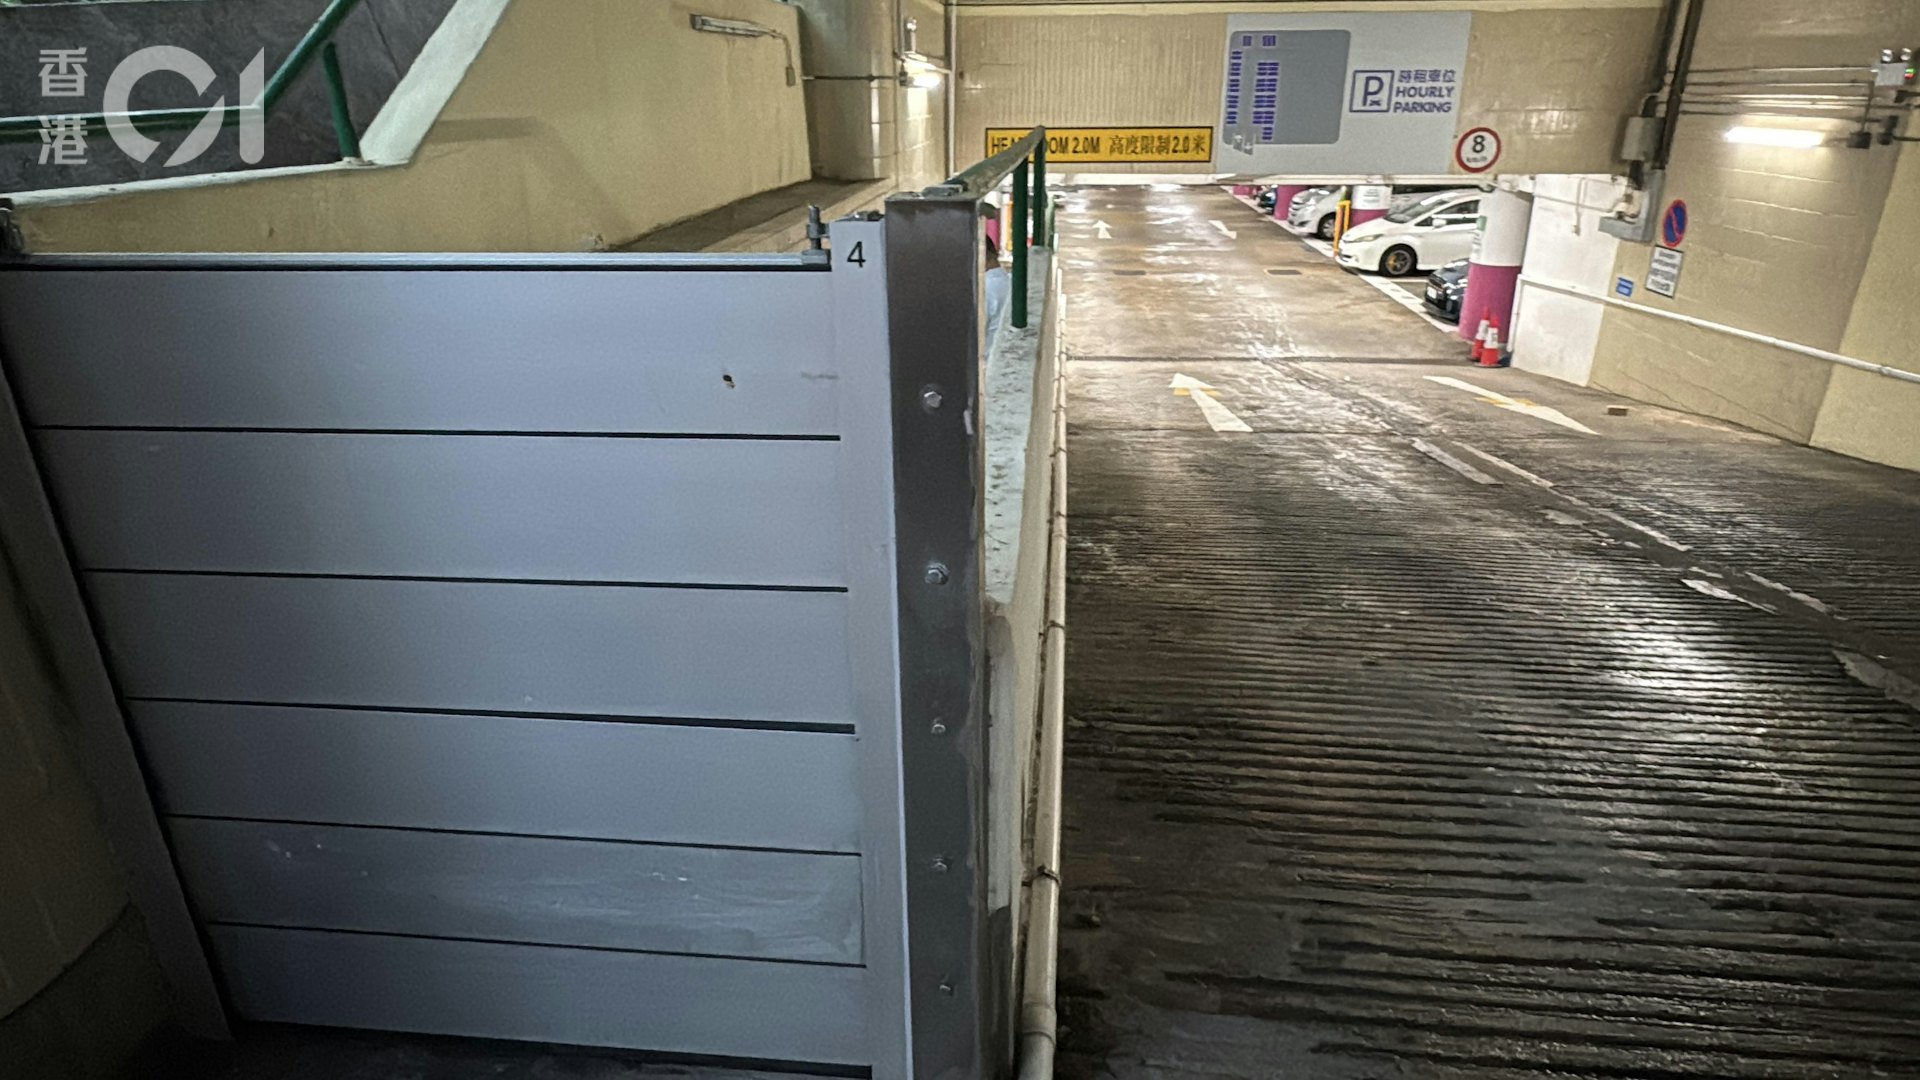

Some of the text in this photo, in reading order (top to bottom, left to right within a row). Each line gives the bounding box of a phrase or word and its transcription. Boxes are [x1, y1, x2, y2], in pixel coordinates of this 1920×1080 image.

[1398, 69, 1456, 83] 時租車位
[1362, 75, 1384, 106] P
[1395, 86, 1454, 98] HOURLY
[1393, 101, 1452, 113] PARKING
[992, 136, 1100, 154] HEOM 2.0M
[1472, 134, 1485, 153] 8
[847, 241, 866, 268] 4
